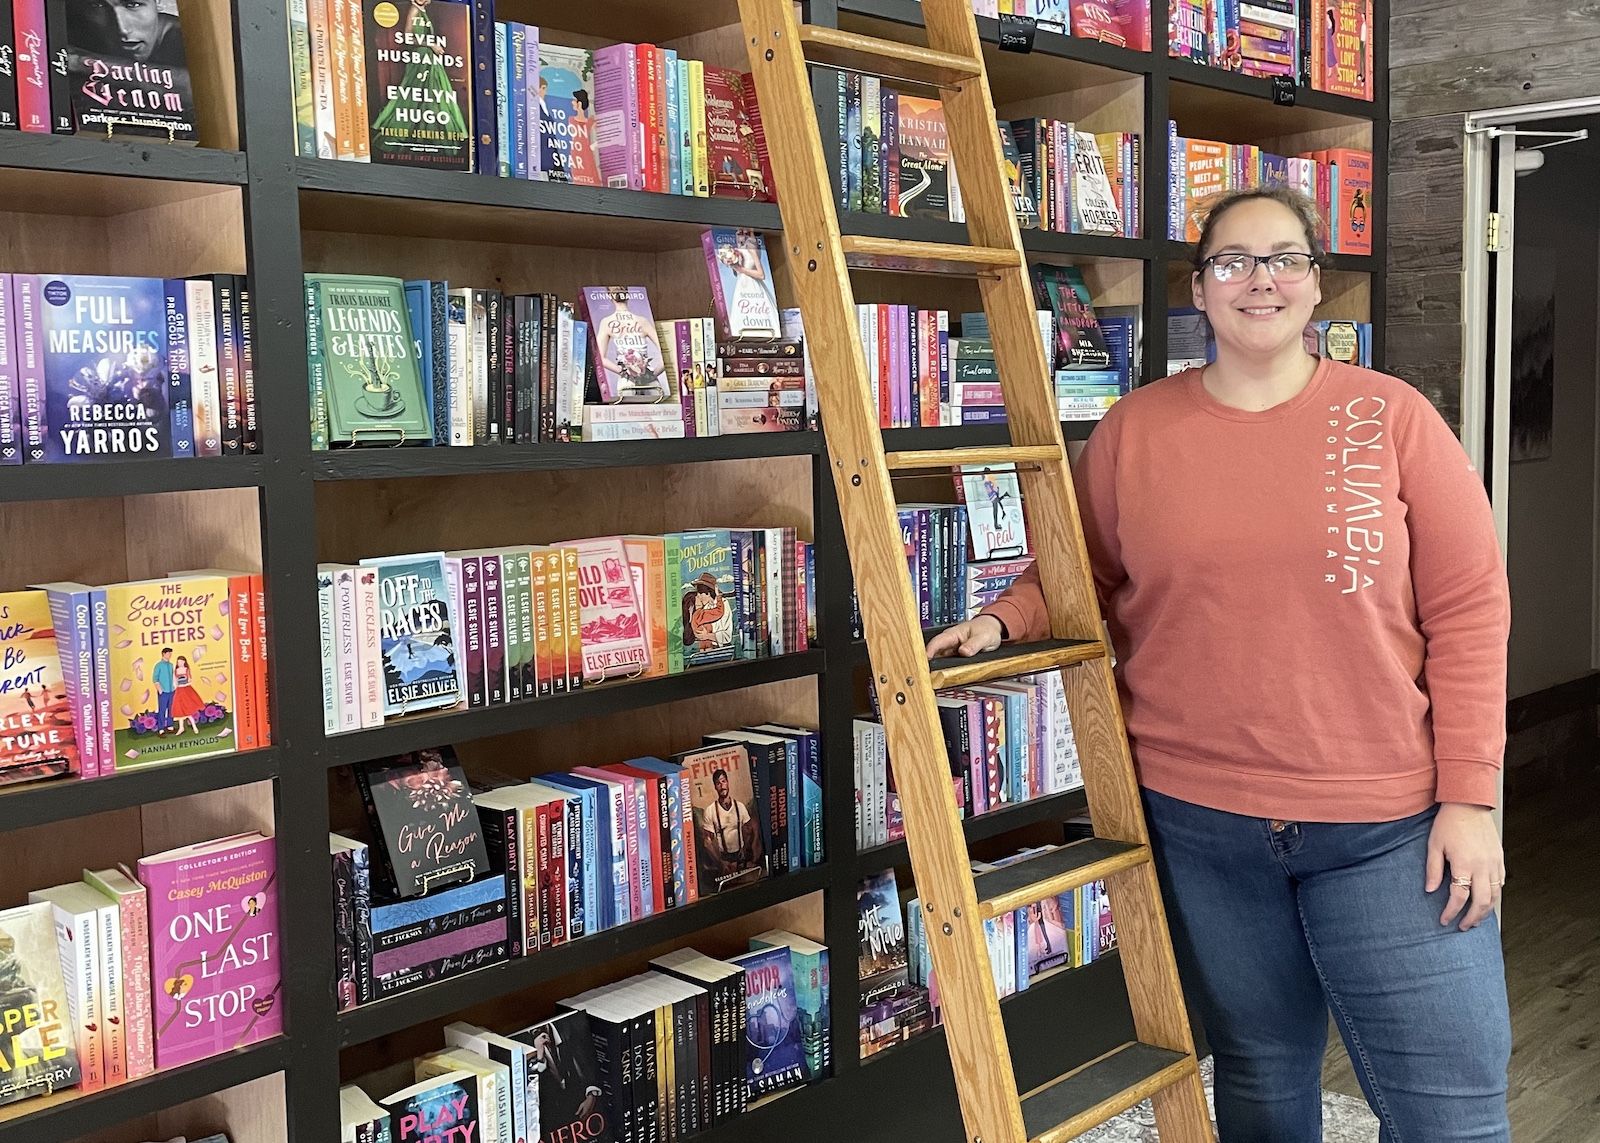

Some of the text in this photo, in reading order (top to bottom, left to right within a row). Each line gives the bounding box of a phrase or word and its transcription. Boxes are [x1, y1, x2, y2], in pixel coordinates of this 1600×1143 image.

[411, 17, 432, 28] The
[1340, 17, 1357, 33] SOME
[394, 31, 447, 48] SEVEN
[1003, 34, 1026, 45] Sports
[1337, 33, 1360, 51] STUPID
[377, 49, 464, 68] HUSBANDS
[512, 31, 525, 81] Reputation
[1340, 51, 1356, 66] LOVE
[84, 58, 174, 90] Darling
[416, 71, 429, 82] of
[1337, 68, 1358, 83] STORY
[81, 80, 183, 112] Venom
[386, 86, 457, 105] EVELYN
[395, 108, 450, 125] HUGO
[552, 108, 566, 119] TO
[900, 116, 945, 133] KRISTIN
[380, 127, 409, 139] TAYLOR
[411, 128, 446, 141] JENKINS
[517, 118, 525, 155] Croucher
[539, 120, 588, 138] SWOON
[900, 134, 945, 149] HANNAH
[548, 138, 583, 152] AND TO
[552, 152, 584, 170] SPAR
[872, 140, 880, 189] IDENTITY
[902, 158, 943, 172] Great Alone
[1189, 157, 1224, 171] PEOPLE WE
[1191, 184, 1222, 198] VACATION
[1193, 173, 1211, 184] MEET
[330, 294, 392, 308] TRAVIS BALDREE
[590, 292, 645, 302] GINNY BAIRD
[740, 290, 764, 299] second
[1058, 287, 1077, 299] THE
[75, 296, 134, 325] FULL
[616, 312, 633, 321] first
[738, 300, 770, 314] Bride
[1057, 301, 1090, 313] LITTLE
[221, 289, 233, 360] IN THE LIKELY EVENT
[327, 307, 402, 334] LEGENDS
[608, 320, 643, 334] Bride
[743, 316, 772, 328] down
[49, 329, 160, 354] MEASURES
[167, 297, 180, 387] PRECIOUS THINGS
[176, 313, 187, 370] GREAT AND
[332, 333, 406, 359] & LATTES
[624, 335, 644, 346] fall
[1078, 339, 1093, 348] MIA
[505, 335, 513, 374] MISTER
[70, 403, 146, 422] REBECCA
[60, 427, 159, 455] YARROS
[1325, 405, 1340, 583] SPORTSWEAR
[1341, 396, 1386, 594] COLUMBIA
[986, 521, 1014, 550] Deal
[687, 547, 727, 573] DUSTED
[160, 584, 182, 595] THE
[381, 574, 419, 607] OFF
[419, 589, 436, 601] THE
[420, 577, 432, 589] TO
[127, 592, 215, 621] Summer
[142, 609, 203, 627] OF LOST
[237, 593, 252, 663] Must Love Books
[320, 593, 331, 658] HEARTLESS
[341, 587, 352, 654] POWERLESS
[365, 591, 375, 648] RECKLESS
[380, 603, 444, 641] RACES
[94, 601, 108, 696] Cool Summer
[141, 626, 206, 646] LETTERS
[4, 647, 26, 670] Be
[75, 604, 91, 699] Cool Summer
[587, 648, 646, 671] ELSIE SILVER
[325, 686, 333, 711] SILVER
[388, 679, 459, 704] ELSIE SILVER
[82, 703, 94, 757] Dahlia Adler
[141, 736, 220, 755] HANNAH REYNOLDS
[691, 754, 742, 779] FIGHT
[615, 792, 624, 840] BOSSMAN
[660, 783, 668, 829] SCORCHED
[770, 785, 779, 837] PROTECT
[778, 787, 787, 828] HONOR
[398, 803, 469, 853] Give Me
[627, 794, 638, 856] INVITATION
[411, 832, 478, 868] a Reason
[507, 815, 517, 872] PLAY DIRTY
[178, 849, 257, 871] COLLECTOR'S EDITION
[168, 885, 204, 901] Casey
[206, 870, 267, 894] McQuiston
[169, 904, 232, 942] ONE
[82, 919, 91, 959] UNDERNEATH
[381, 929, 423, 945] A.L. JACKSON
[200, 933, 272, 979] LAST
[85, 972, 93, 1003] SYCAMORE
[395, 974, 424, 990] JACKSON
[185, 985, 256, 1029] STOP
[621, 1049, 630, 1085] KING
[633, 1044, 642, 1080] DOM
[646, 1040, 656, 1080] HANS
[400, 1095, 468, 1140] PLAY
